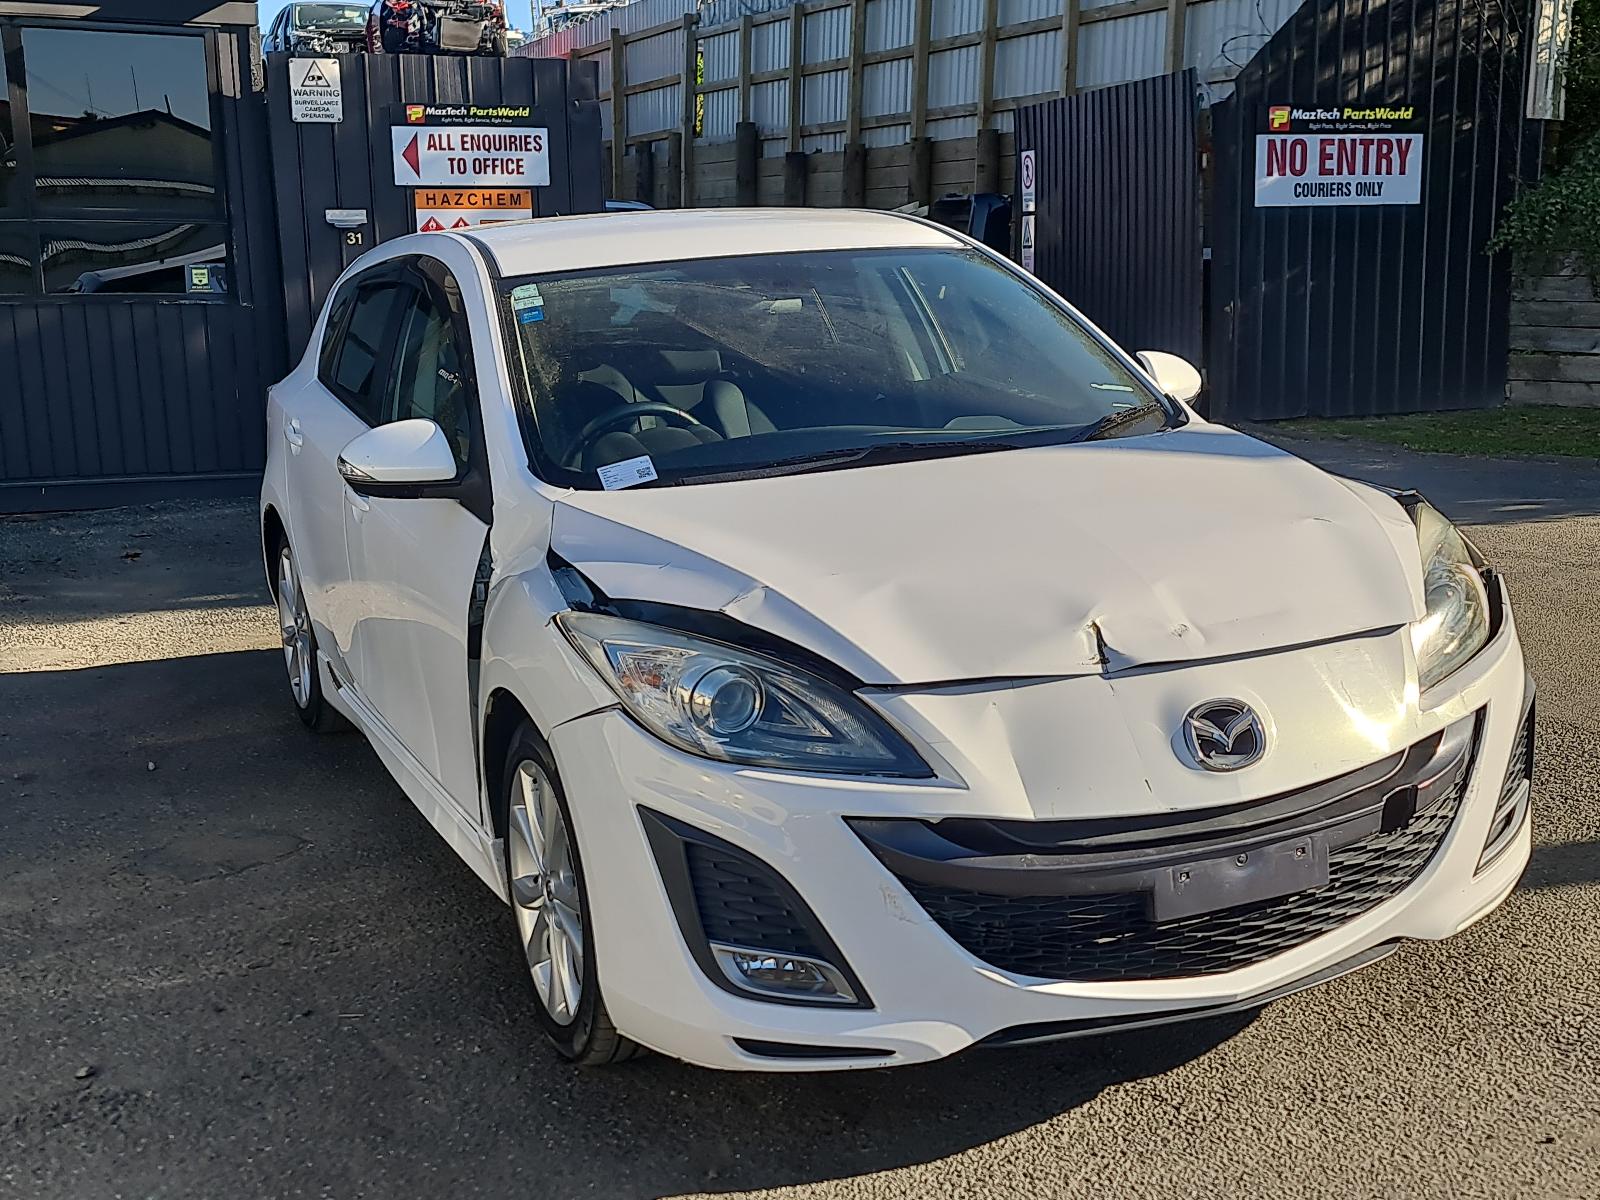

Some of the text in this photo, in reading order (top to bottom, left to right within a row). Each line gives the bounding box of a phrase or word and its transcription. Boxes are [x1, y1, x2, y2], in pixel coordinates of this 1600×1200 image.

[292, 88, 340, 97] WARNING
[425, 106, 467, 116] MazTech
[469, 106, 530, 117] PartsWorld
[1290, 107, 1340, 120] MazTech
[1342, 106, 1414, 120] PartsWorld
[427, 133, 543, 153] ALL ENQUIRIES
[1266, 138, 1413, 177] NO ENTRY
[447, 157, 525, 176] TO OFFICE
[1293, 181, 1384, 198] COURIERS ONLY
[425, 193, 522, 206] HAZCHEM
[346, 232, 363, 245] 31
